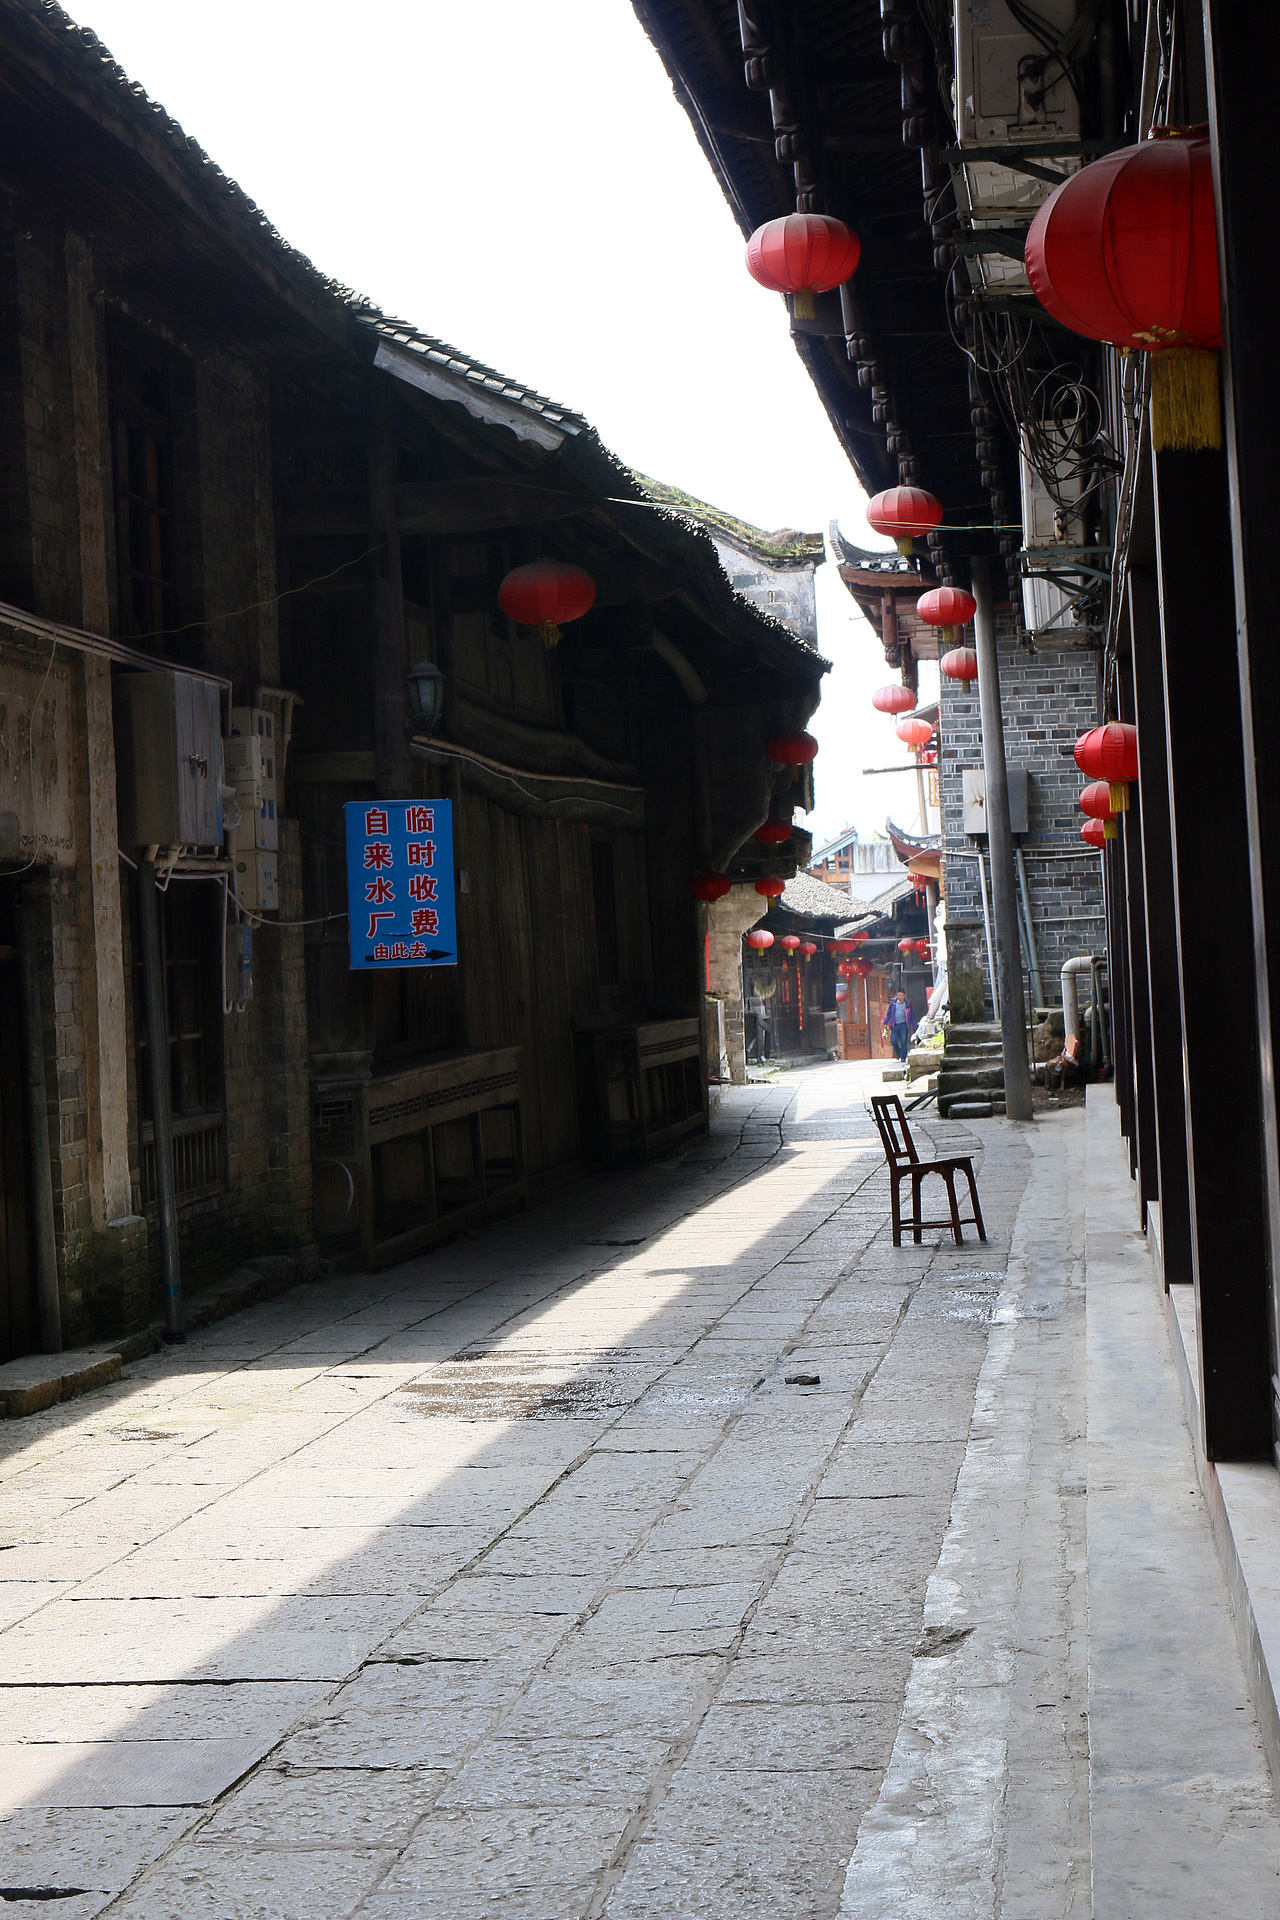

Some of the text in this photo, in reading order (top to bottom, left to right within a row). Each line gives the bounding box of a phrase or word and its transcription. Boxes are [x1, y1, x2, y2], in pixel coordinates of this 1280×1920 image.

[363, 808, 395, 938] 自来水厂
[405, 806, 439, 936] 临时收费
[374, 941, 427, 960] 由此去
